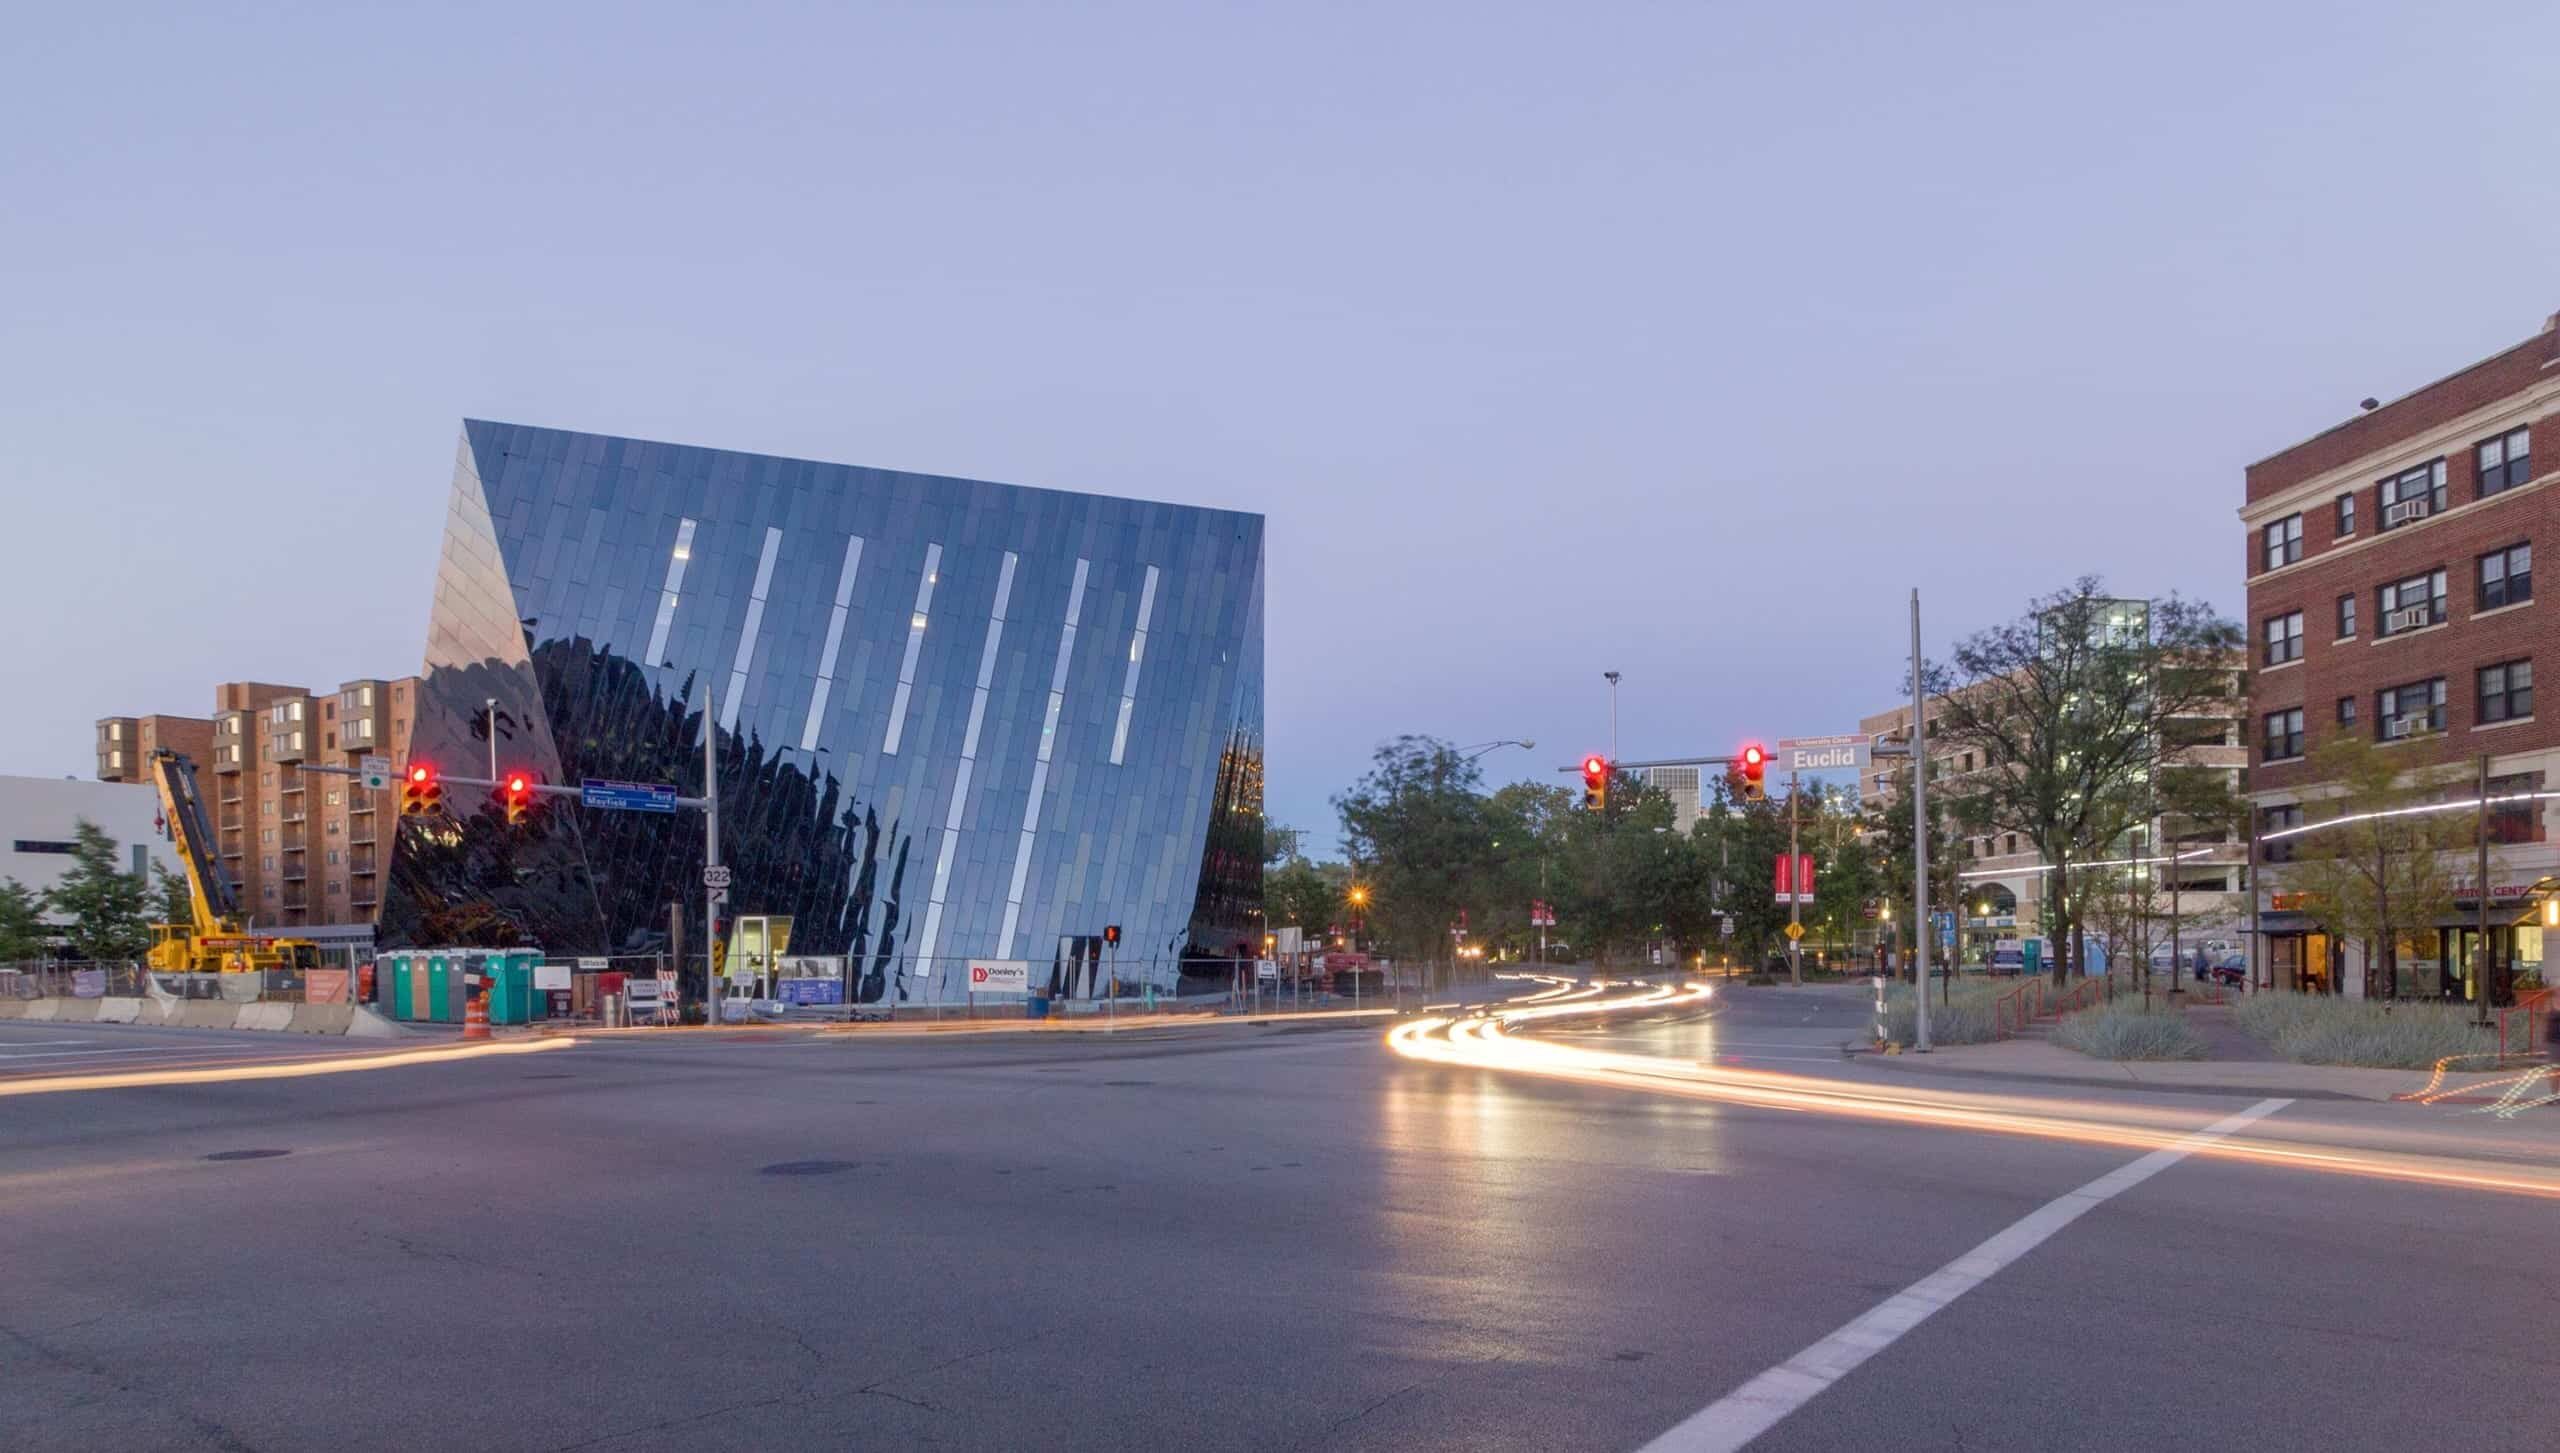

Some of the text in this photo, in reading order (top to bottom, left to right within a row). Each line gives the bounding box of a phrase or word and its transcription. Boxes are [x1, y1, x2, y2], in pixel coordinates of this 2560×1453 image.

[1794, 748, 1855, 768] Euclid
[587, 796, 626, 808] Mayfield
[706, 871, 729, 882] 322
[989, 967, 1024, 977] Donley's
